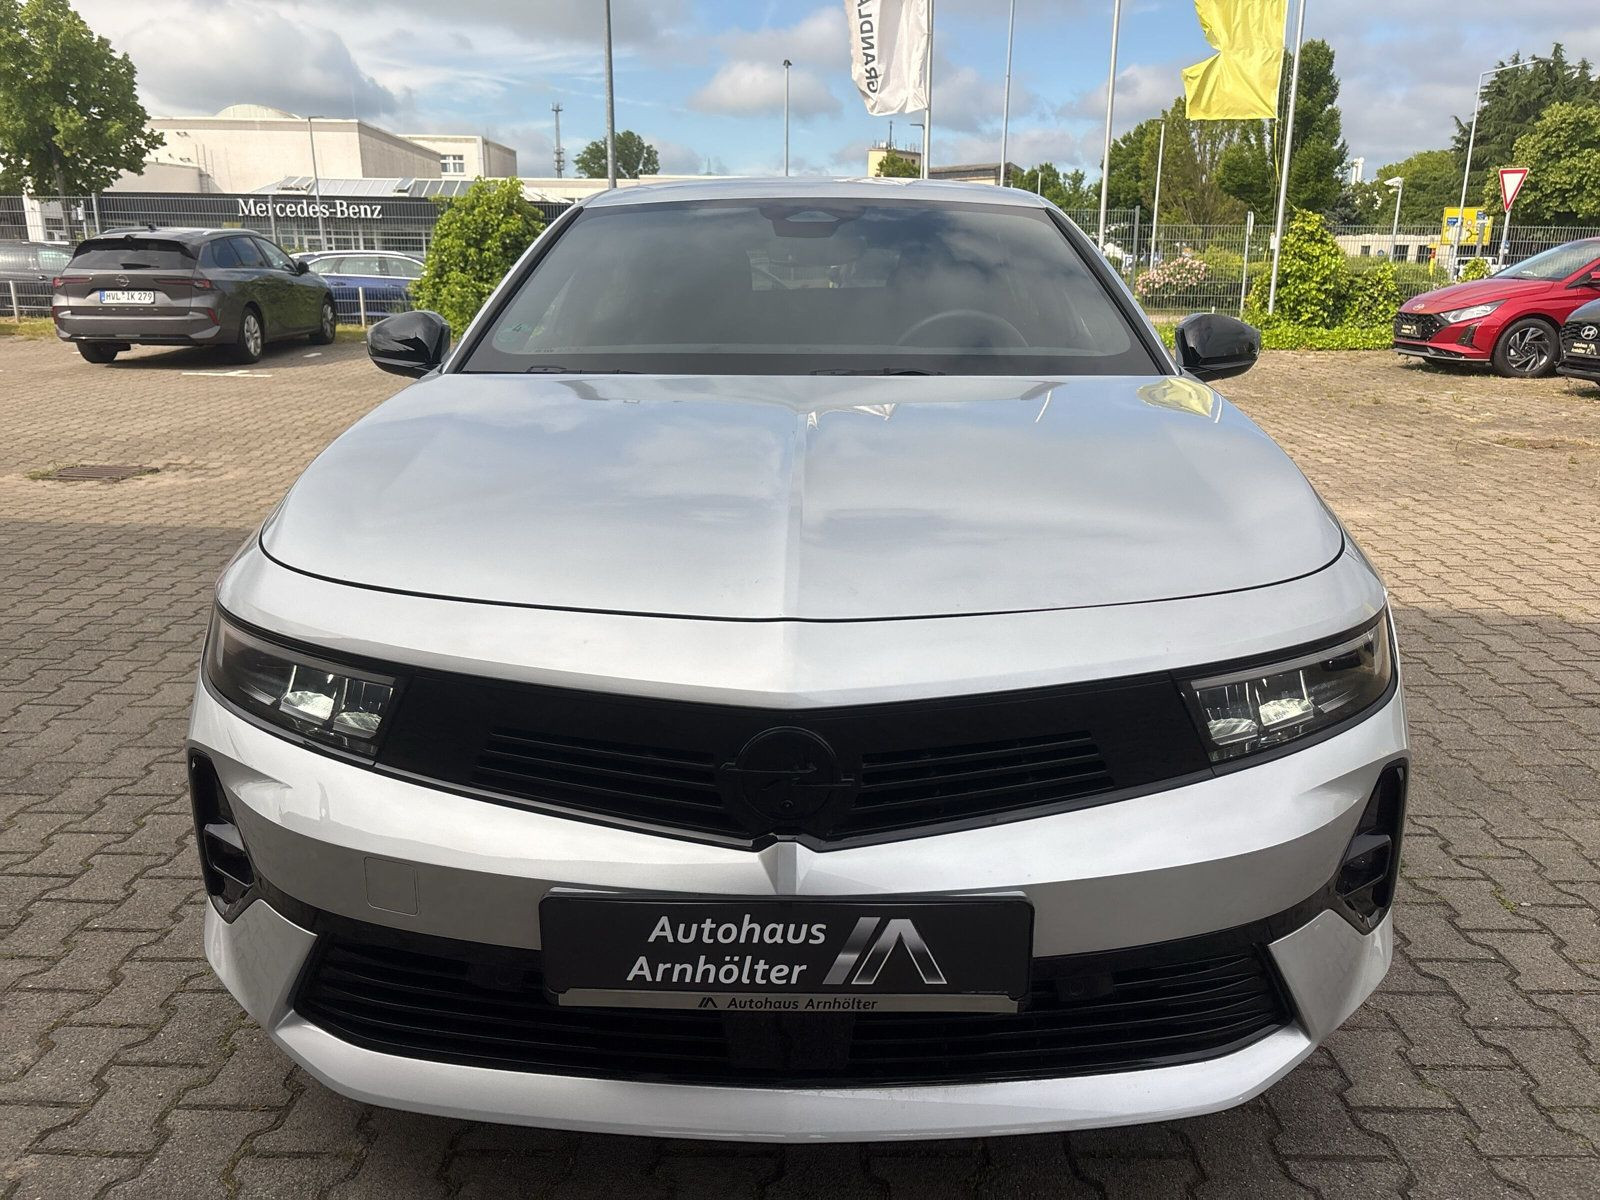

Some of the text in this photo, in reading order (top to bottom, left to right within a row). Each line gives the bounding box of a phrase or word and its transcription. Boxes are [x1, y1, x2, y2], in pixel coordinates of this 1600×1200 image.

[237, 198, 382, 219] Mercedes-Benz
[138, 292, 152, 301] 279
[648, 914, 827, 944] Autohaus
[626, 955, 807, 985] Arnhölter
[727, 997, 878, 1010] Autohaus Arnhölter
